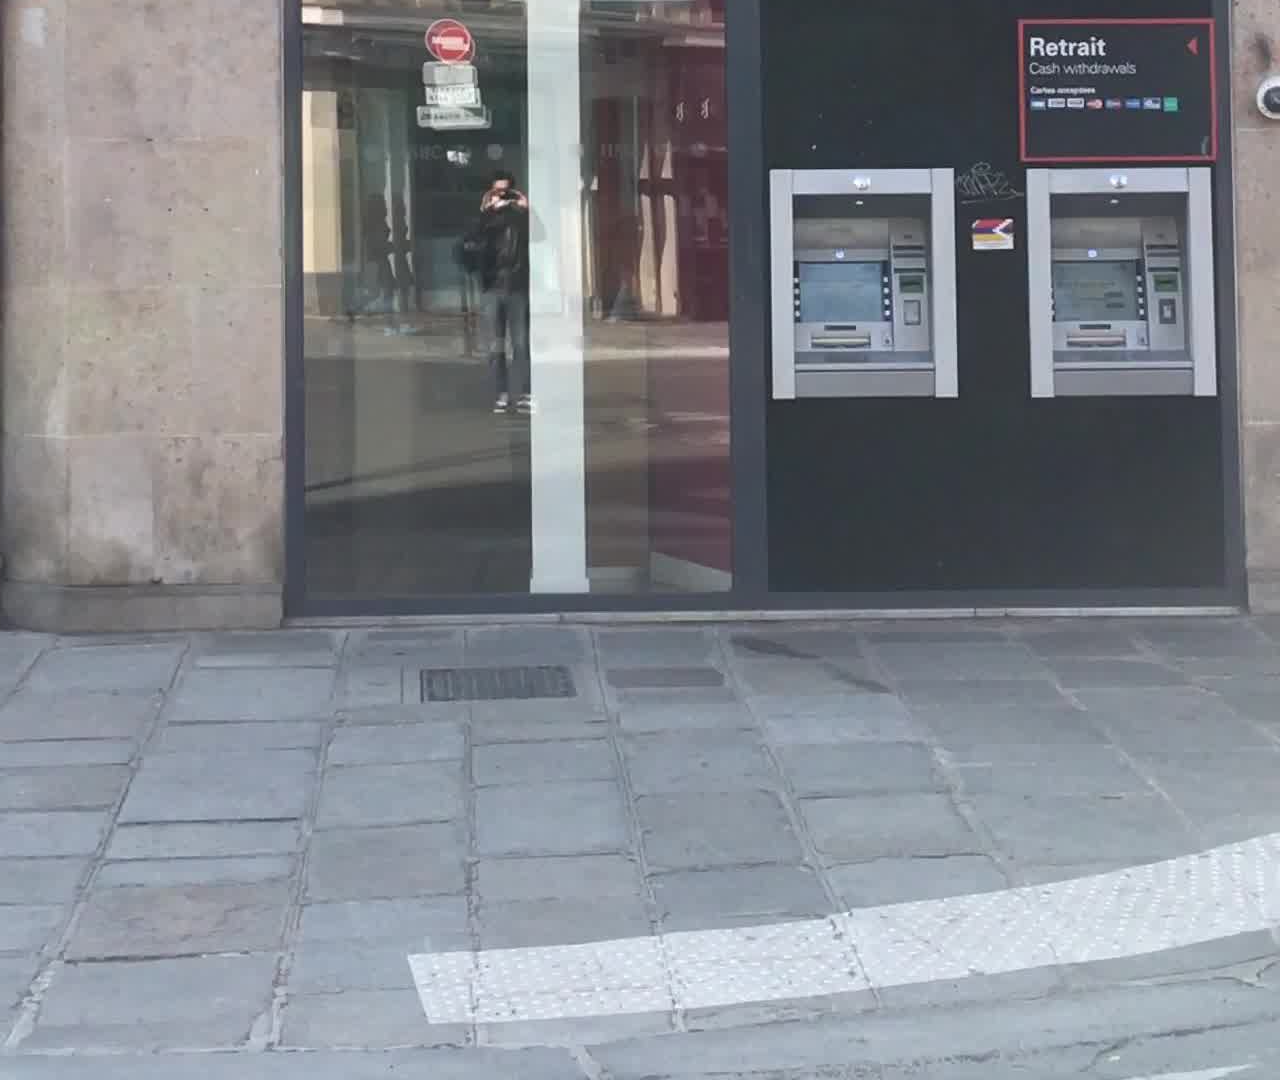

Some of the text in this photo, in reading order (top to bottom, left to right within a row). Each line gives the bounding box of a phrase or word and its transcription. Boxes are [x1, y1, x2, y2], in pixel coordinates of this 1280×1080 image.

[1029, 36, 1107, 57] Retrait
[1029, 62, 1137, 75] Cash withdrawals
